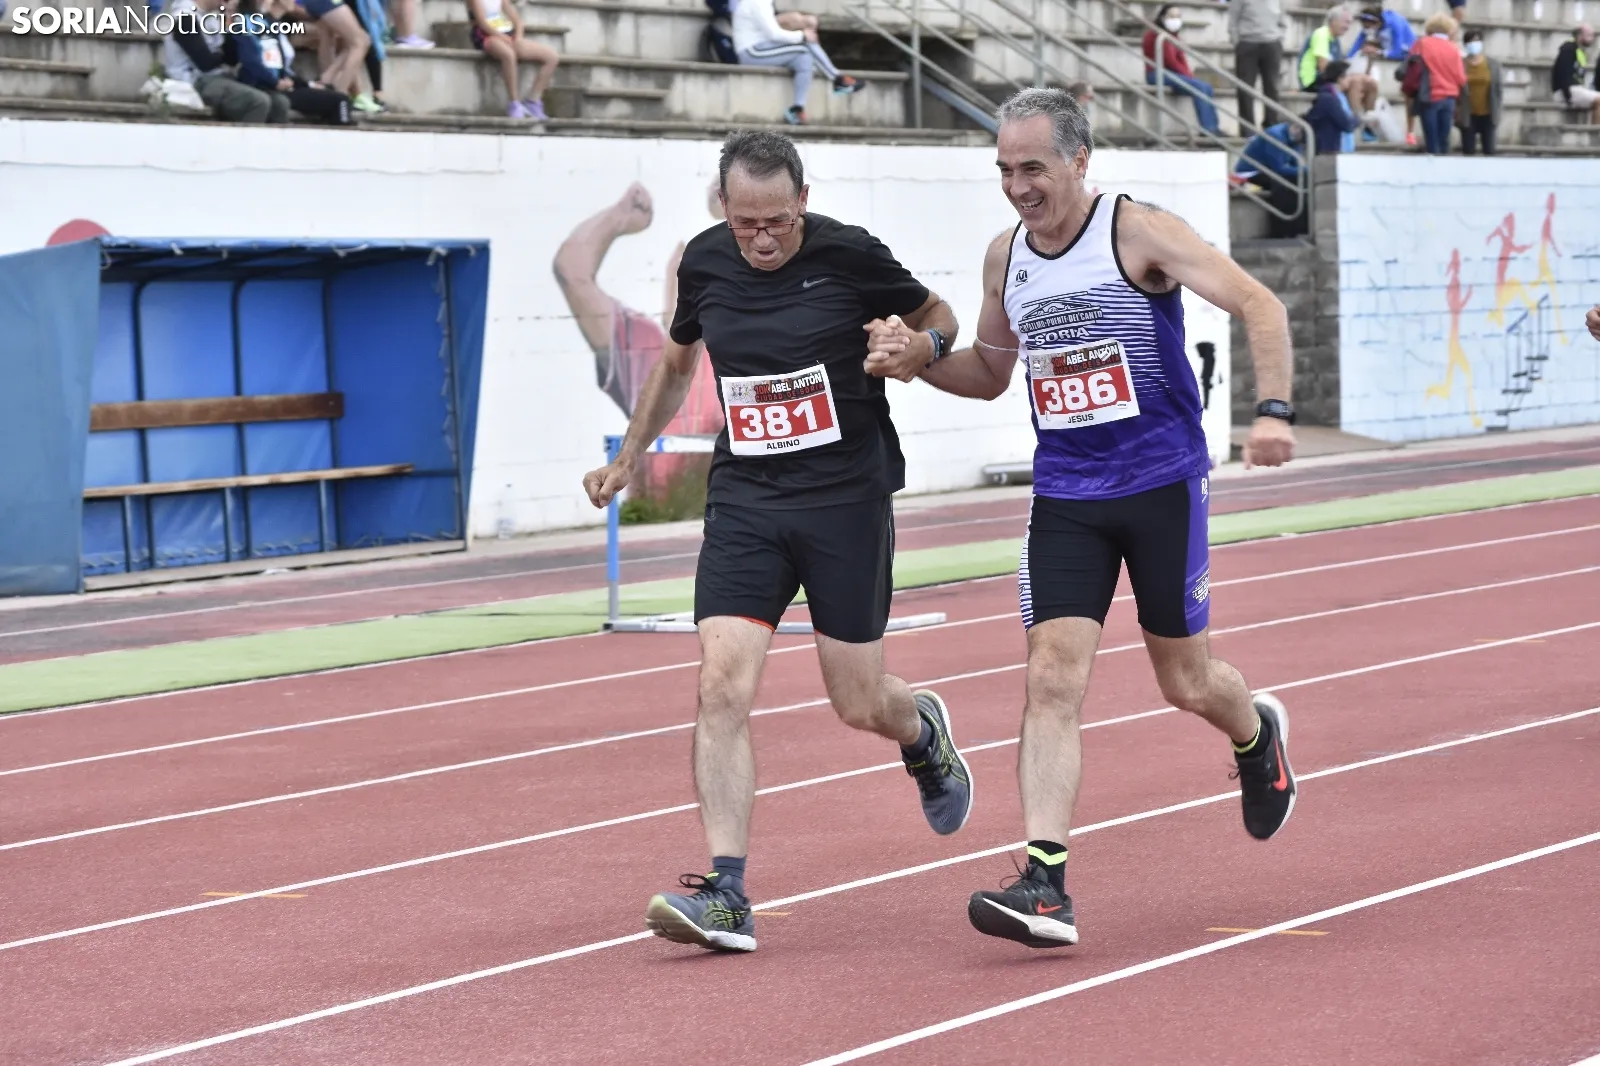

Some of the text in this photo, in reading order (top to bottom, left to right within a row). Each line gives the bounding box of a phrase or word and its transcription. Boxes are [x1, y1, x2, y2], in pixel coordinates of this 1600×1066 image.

[1034, 326, 1091, 345] SORIA
[1066, 352, 1088, 366] ABEL
[1088, 344, 1118, 360] ANTÓN
[755, 372, 823, 395] 10K ABEL ANTÓN
[755, 393, 783, 402] CIUDAD
[800, 384, 824, 395] SORIA
[1041, 371, 1117, 412] 386
[739, 399, 818, 439] 381
[1067, 413, 1095, 424] JESUS
[766, 438, 800, 450] ALBINO
